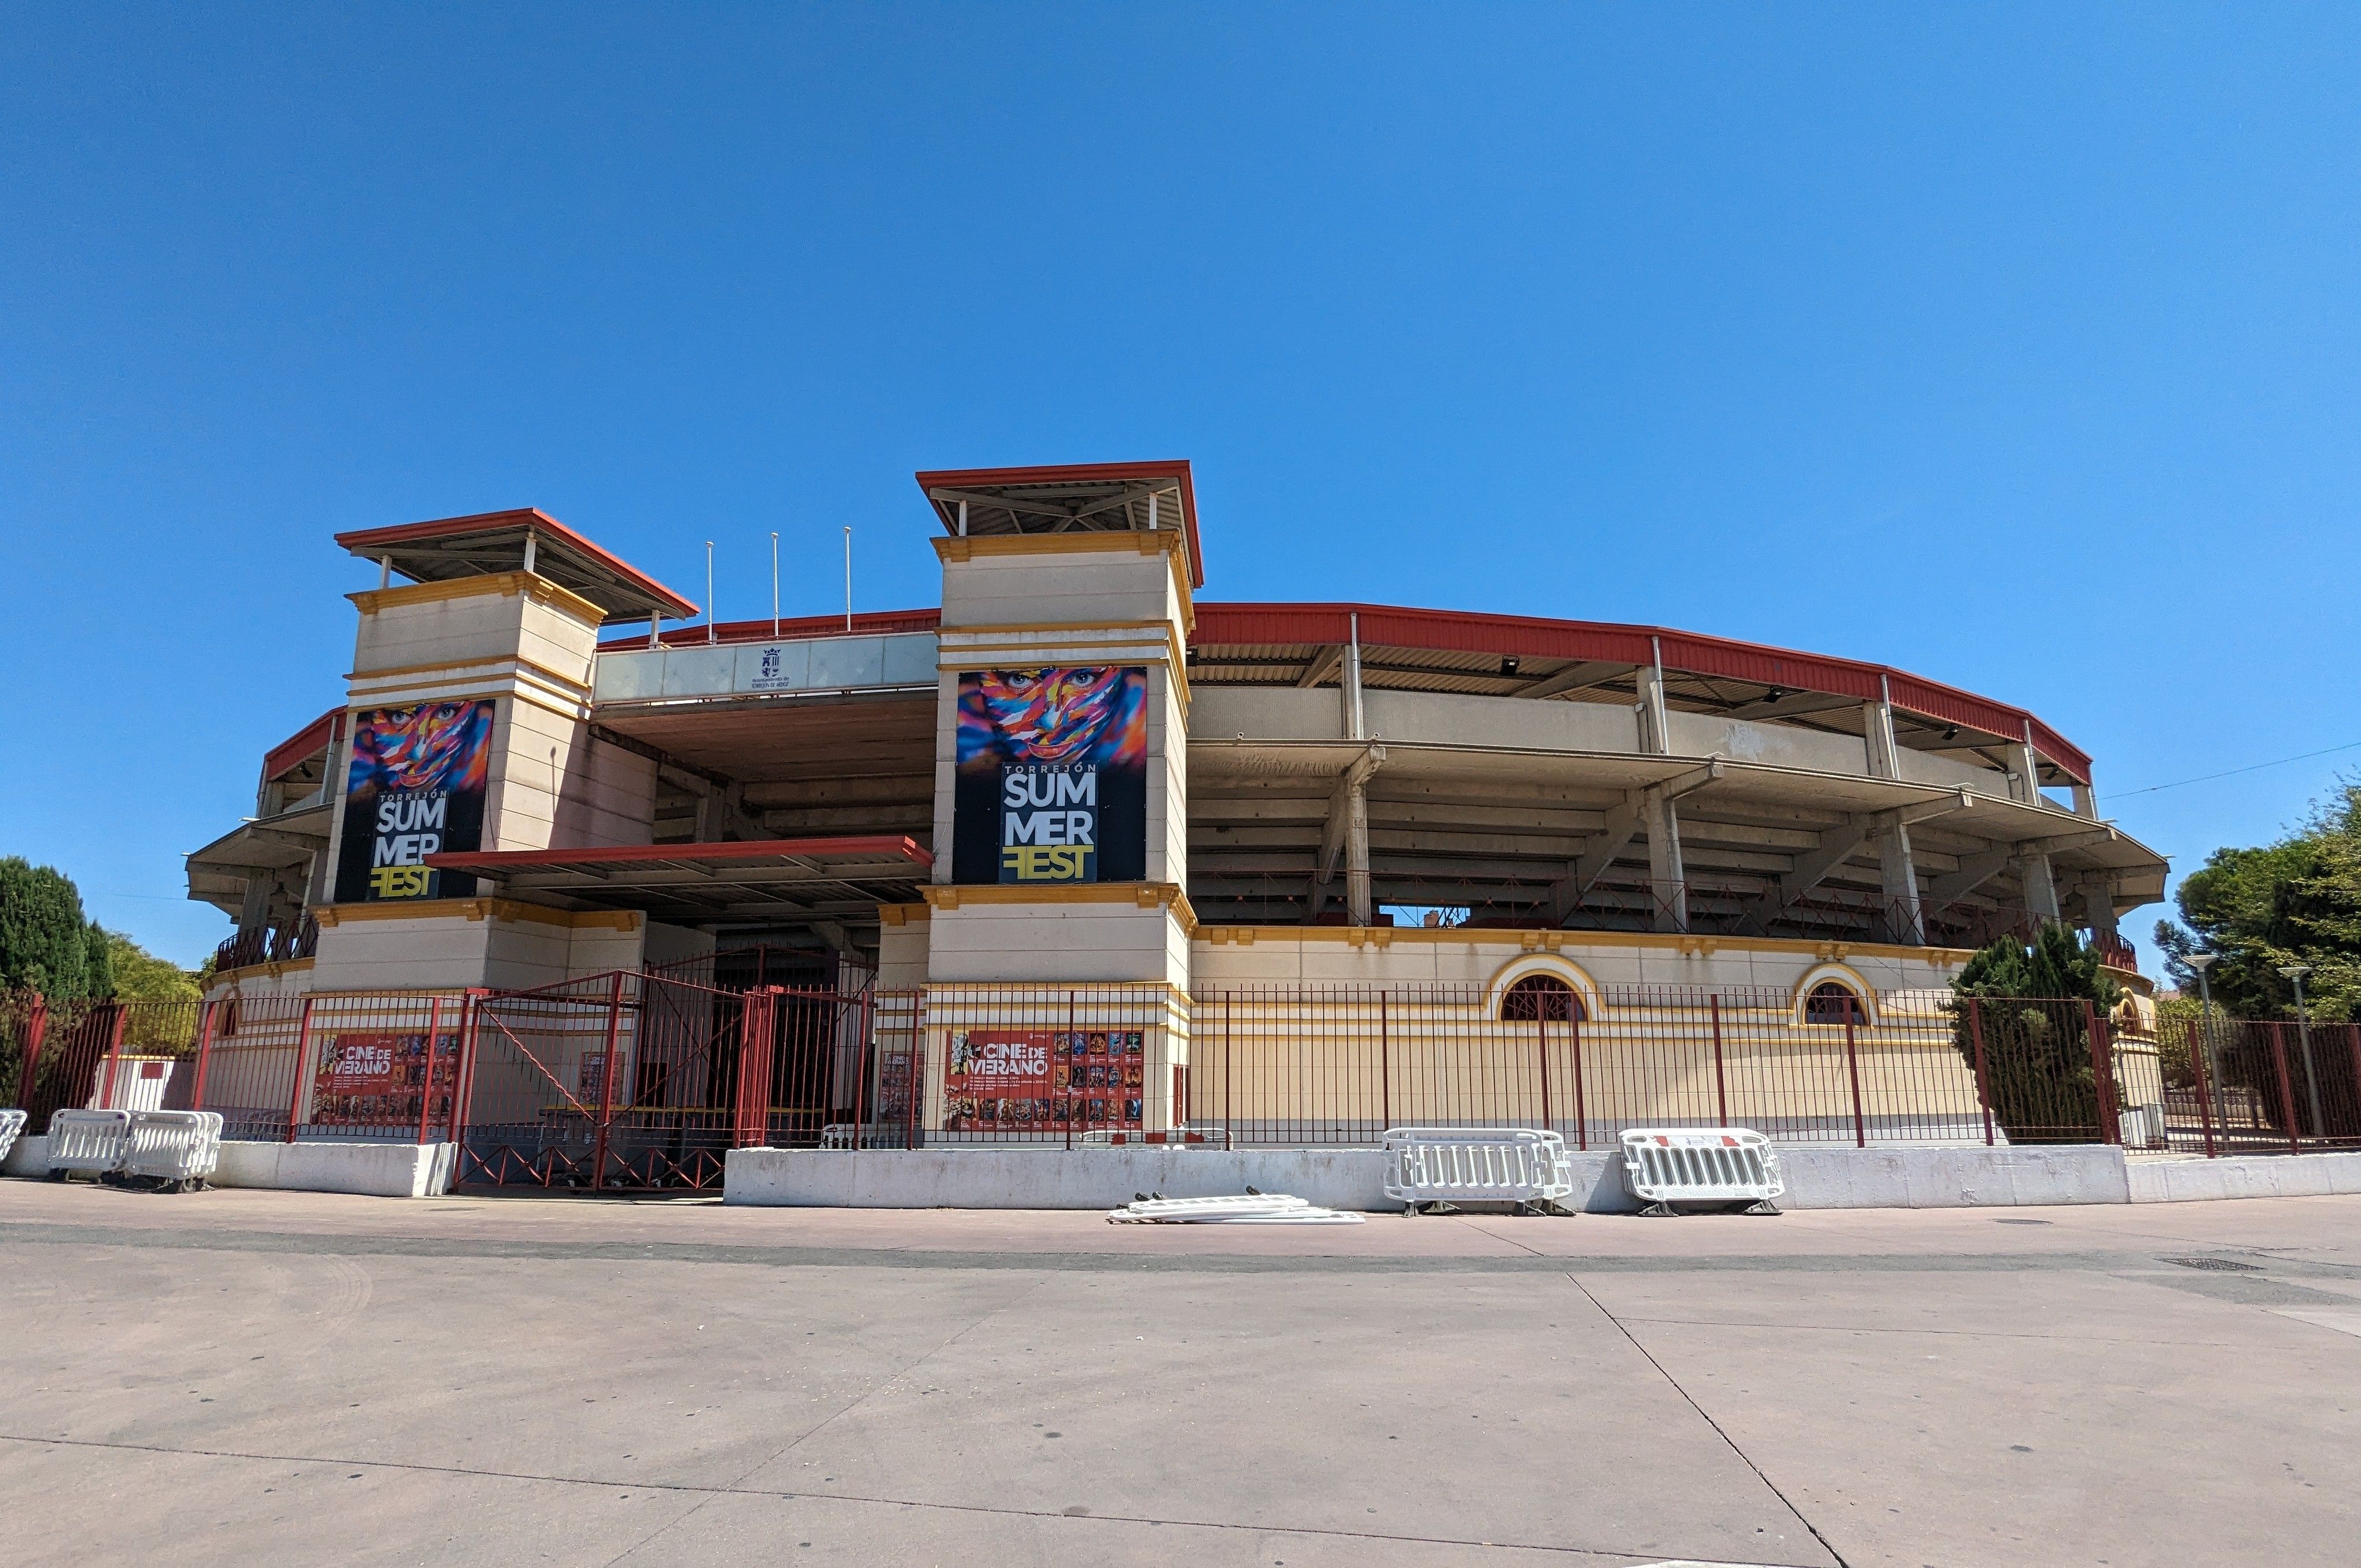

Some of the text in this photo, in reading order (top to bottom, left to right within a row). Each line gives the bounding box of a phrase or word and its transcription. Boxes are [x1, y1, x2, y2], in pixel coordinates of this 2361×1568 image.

[1005, 762, 1096, 774] TORREJÓN
[380, 788, 447, 803] TORREJÓN
[1003, 772, 1096, 808] SUM
[376, 798, 446, 833] SUM
[1005, 811, 1094, 846] MER
[1002, 845, 1094, 880] FEST
[347, 1046, 377, 1061] CINE
[377, 1049, 392, 1060] DE
[984, 1043, 1027, 1059] CINE
[1028, 1047, 1048, 1059] DE
[334, 1060, 391, 1074] VERANO
[969, 1059, 1049, 1076] VERANO
